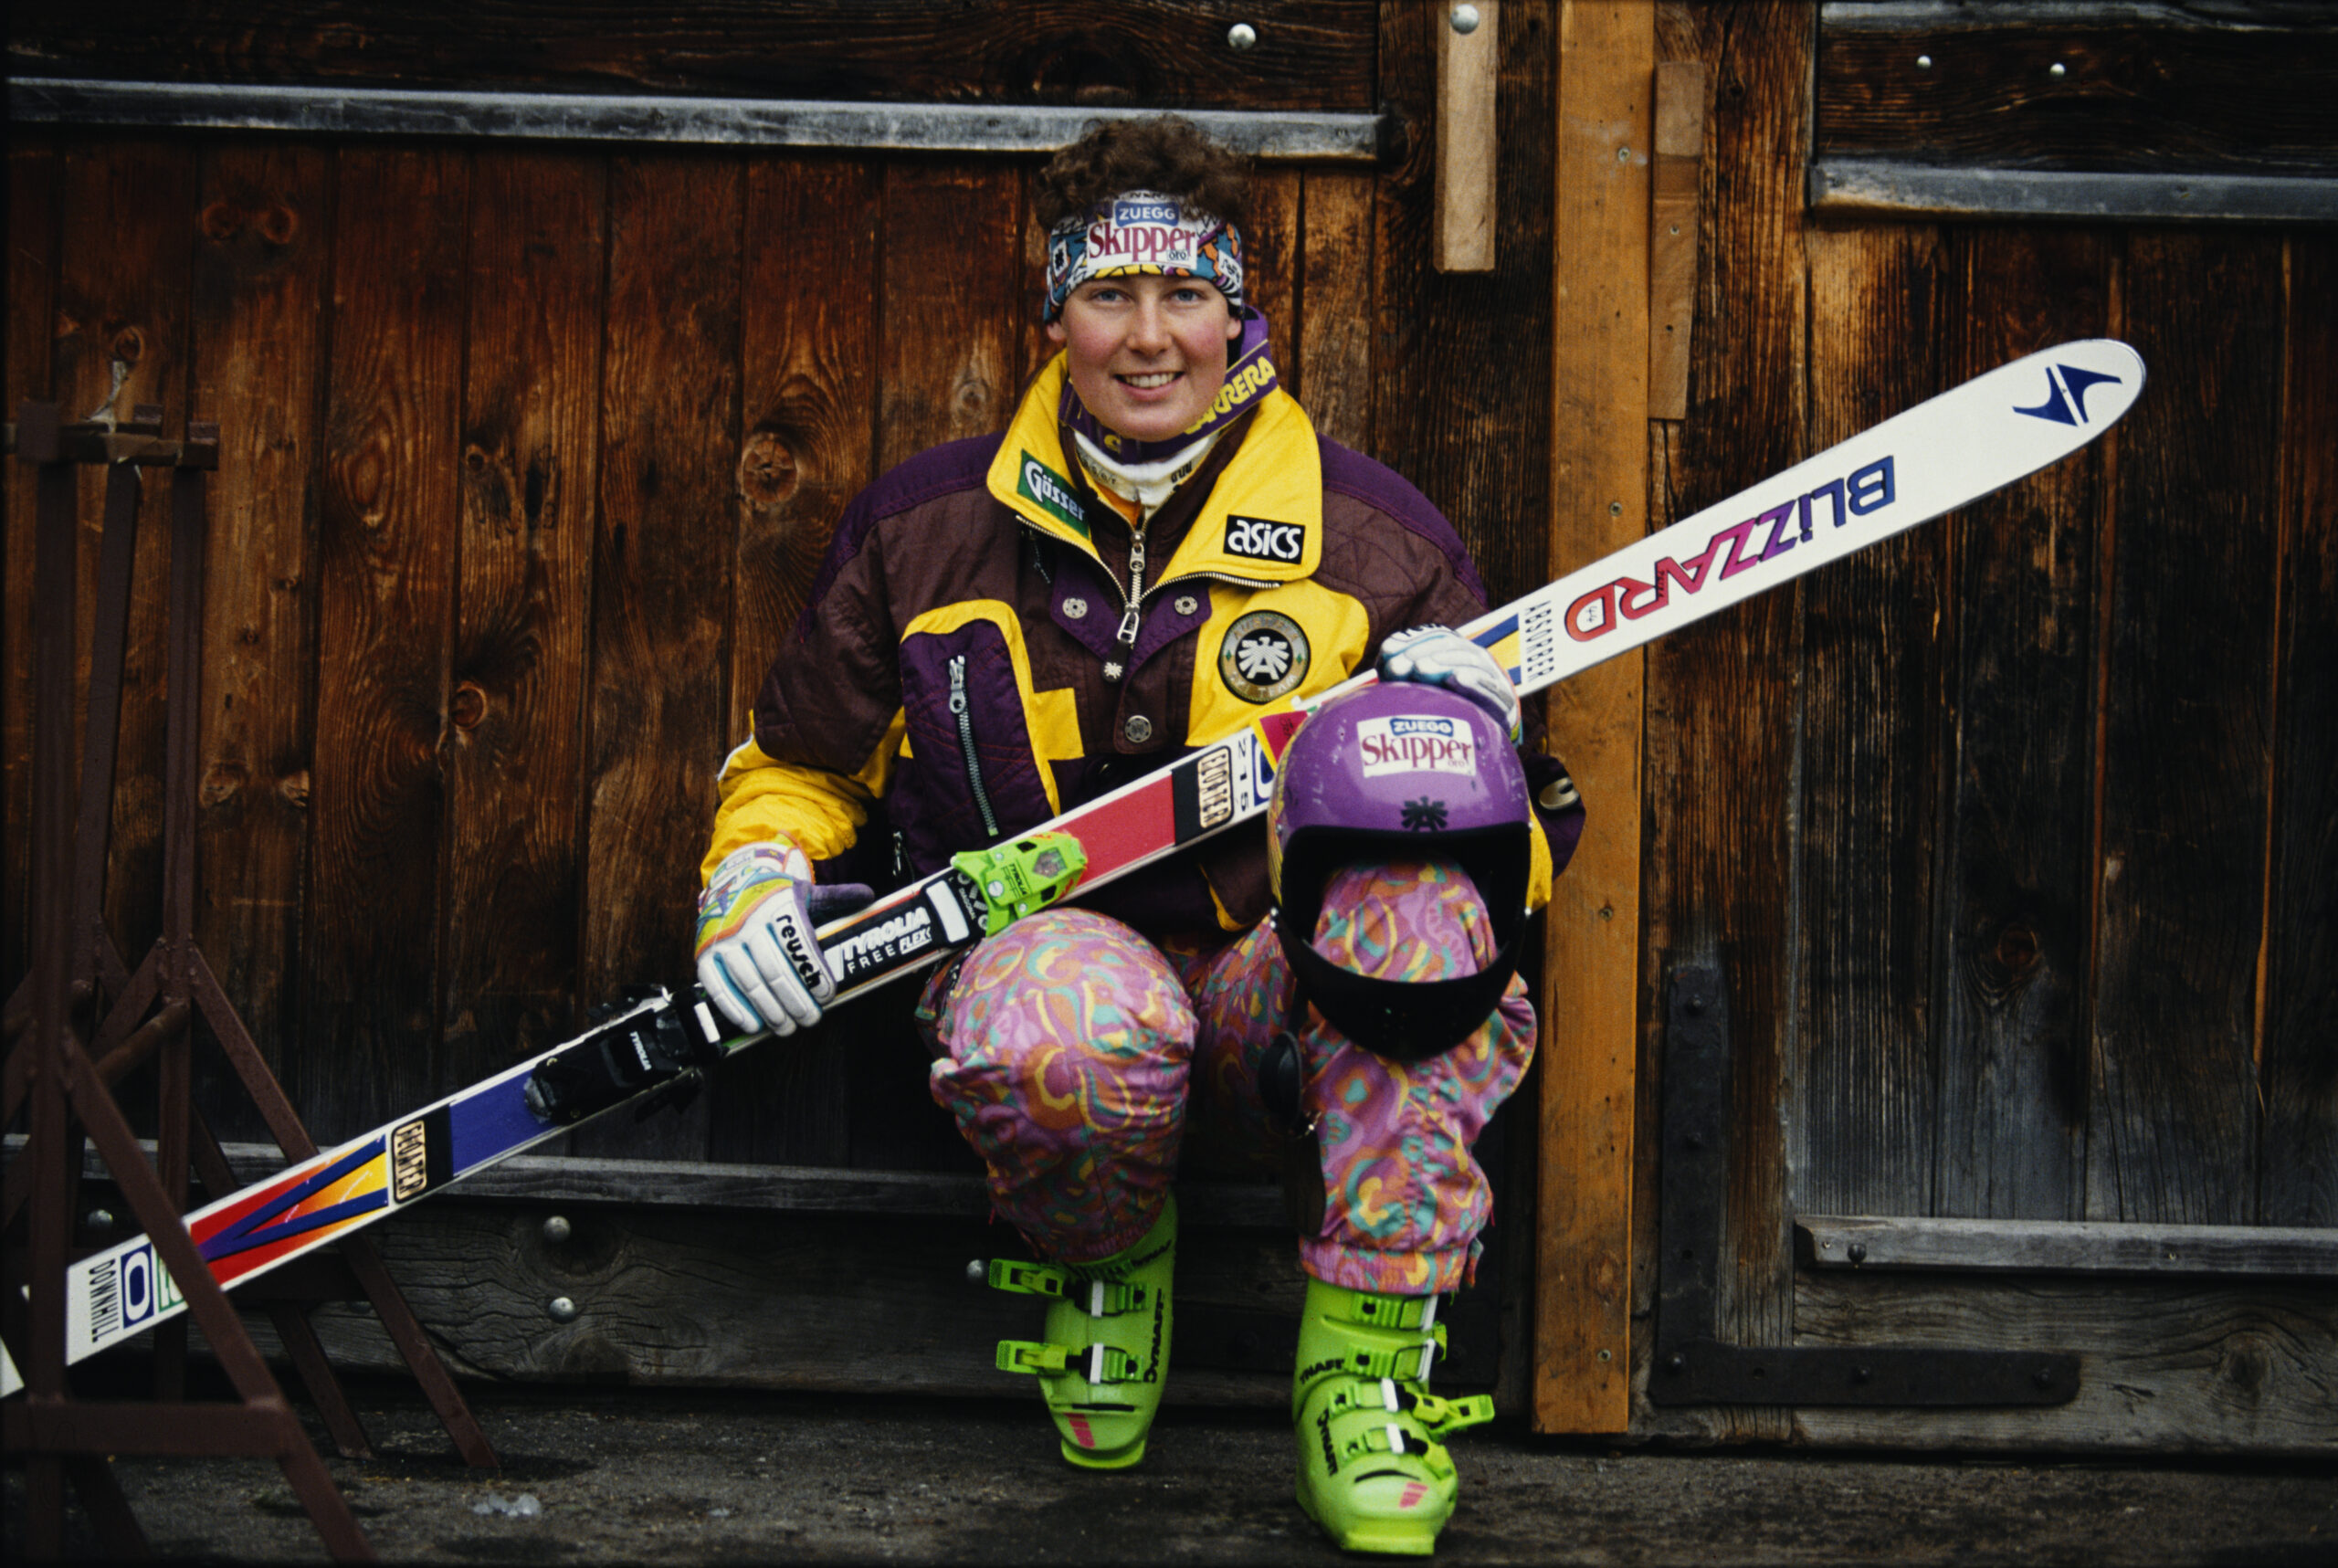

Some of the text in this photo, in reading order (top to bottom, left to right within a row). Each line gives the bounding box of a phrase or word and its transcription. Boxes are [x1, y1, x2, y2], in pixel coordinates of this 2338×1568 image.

[1118, 207, 1175, 221] ZUEGG
[1089, 222, 1195, 262] Skipper
[1025, 460, 1085, 521] Gösser
[1227, 519, 1301, 560] asics
[1392, 720, 1452, 733] ZUEGG
[1361, 732, 1472, 769] Skipper
[776, 914, 821, 991] reusch
[839, 906, 932, 962] TYROLIA
[847, 943, 897, 974] FREE
[89, 1258, 120, 1343] DOWNHILL
